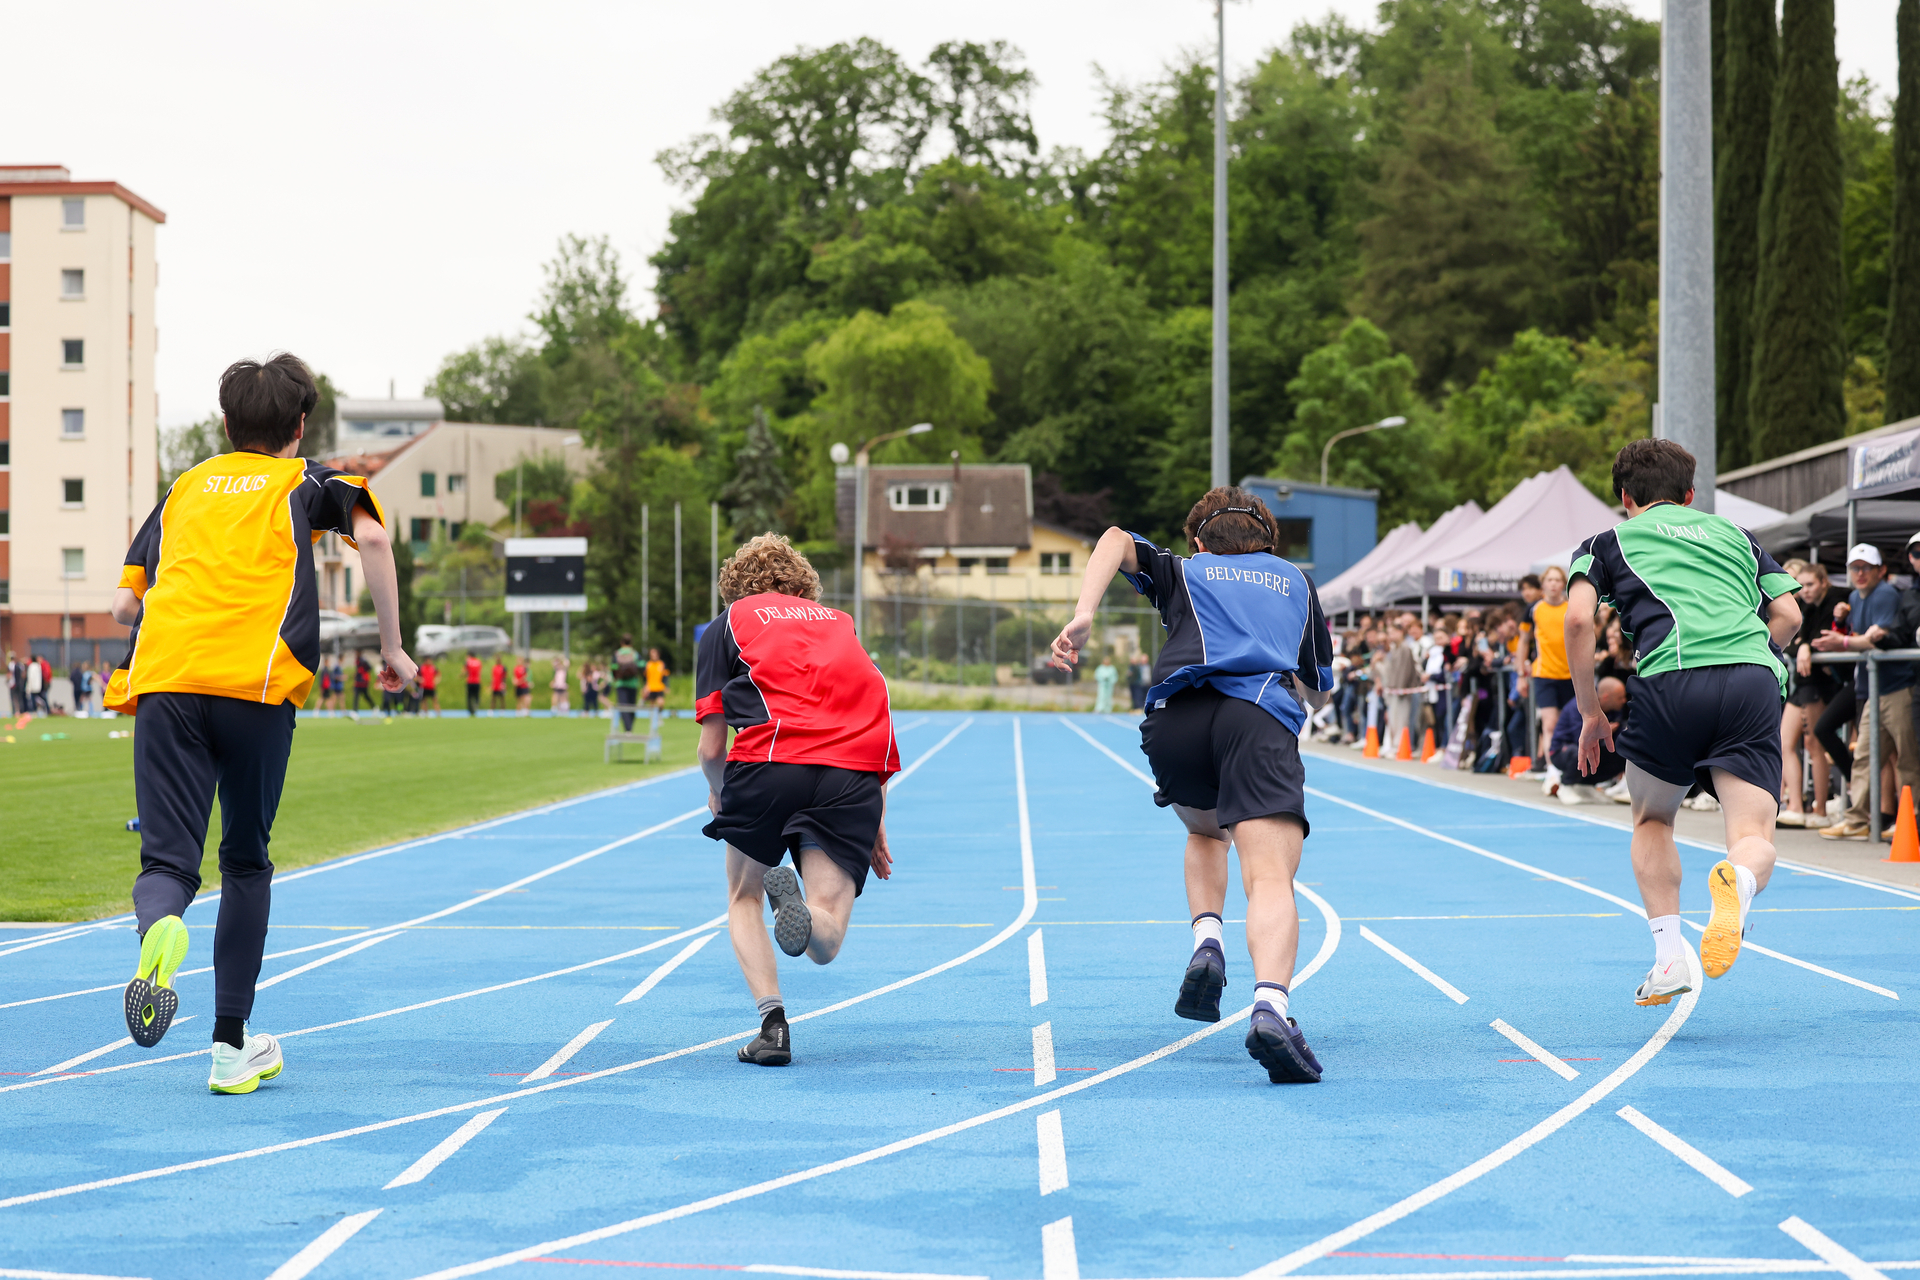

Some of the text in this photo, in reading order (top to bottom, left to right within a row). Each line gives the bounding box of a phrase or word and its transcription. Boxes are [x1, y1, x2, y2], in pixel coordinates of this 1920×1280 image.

[203, 474, 270, 494] ST LOUIS
[1656, 523, 1710, 540] ALPINA
[1205, 566, 1291, 597] BELVEDERE
[753, 606, 837, 625] DELAWARE
